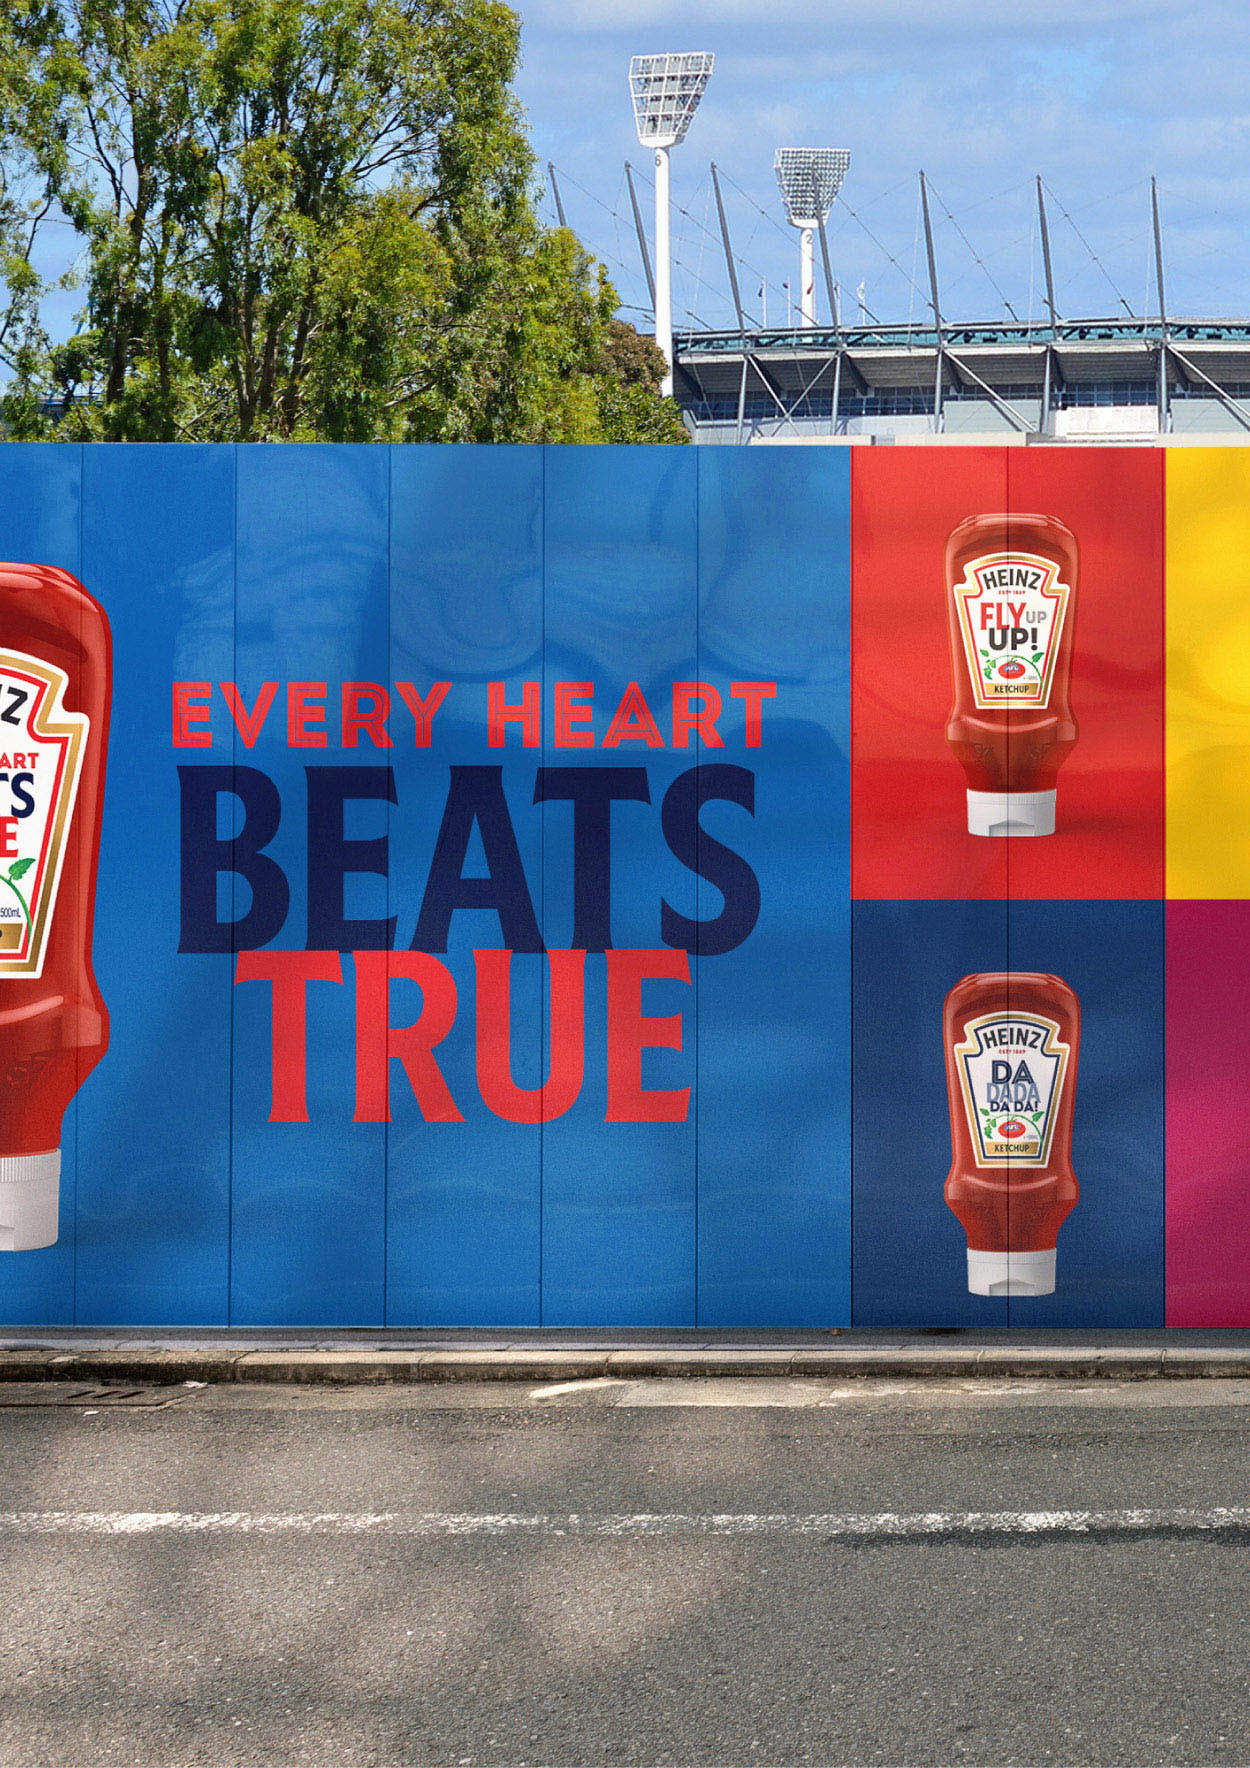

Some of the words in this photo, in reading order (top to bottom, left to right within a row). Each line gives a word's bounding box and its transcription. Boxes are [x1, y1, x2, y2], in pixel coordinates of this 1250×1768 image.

[655, 154, 662, 167] 6
[805, 233, 814, 245] 2
[982, 568, 1041, 590] HEINZ
[980, 602, 1027, 630] FLY
[1026, 612, 1046, 623] UP
[989, 628, 1038, 650] UP!
[994, 685, 1029, 693] KETCHUP
[173, 682, 452, 748] EVERY
[488, 682, 778, 748] HEART
[0, 752, 39, 769] ART
[177, 763, 761, 956] BEATS
[234, 949, 692, 1124] TRUE
[983, 1028, 1042, 1049] HEINZ
[992, 1060, 1034, 1084] DA
[990, 1101, 1010, 1112] DA
[1014, 1101, 1038, 1112] DA!
